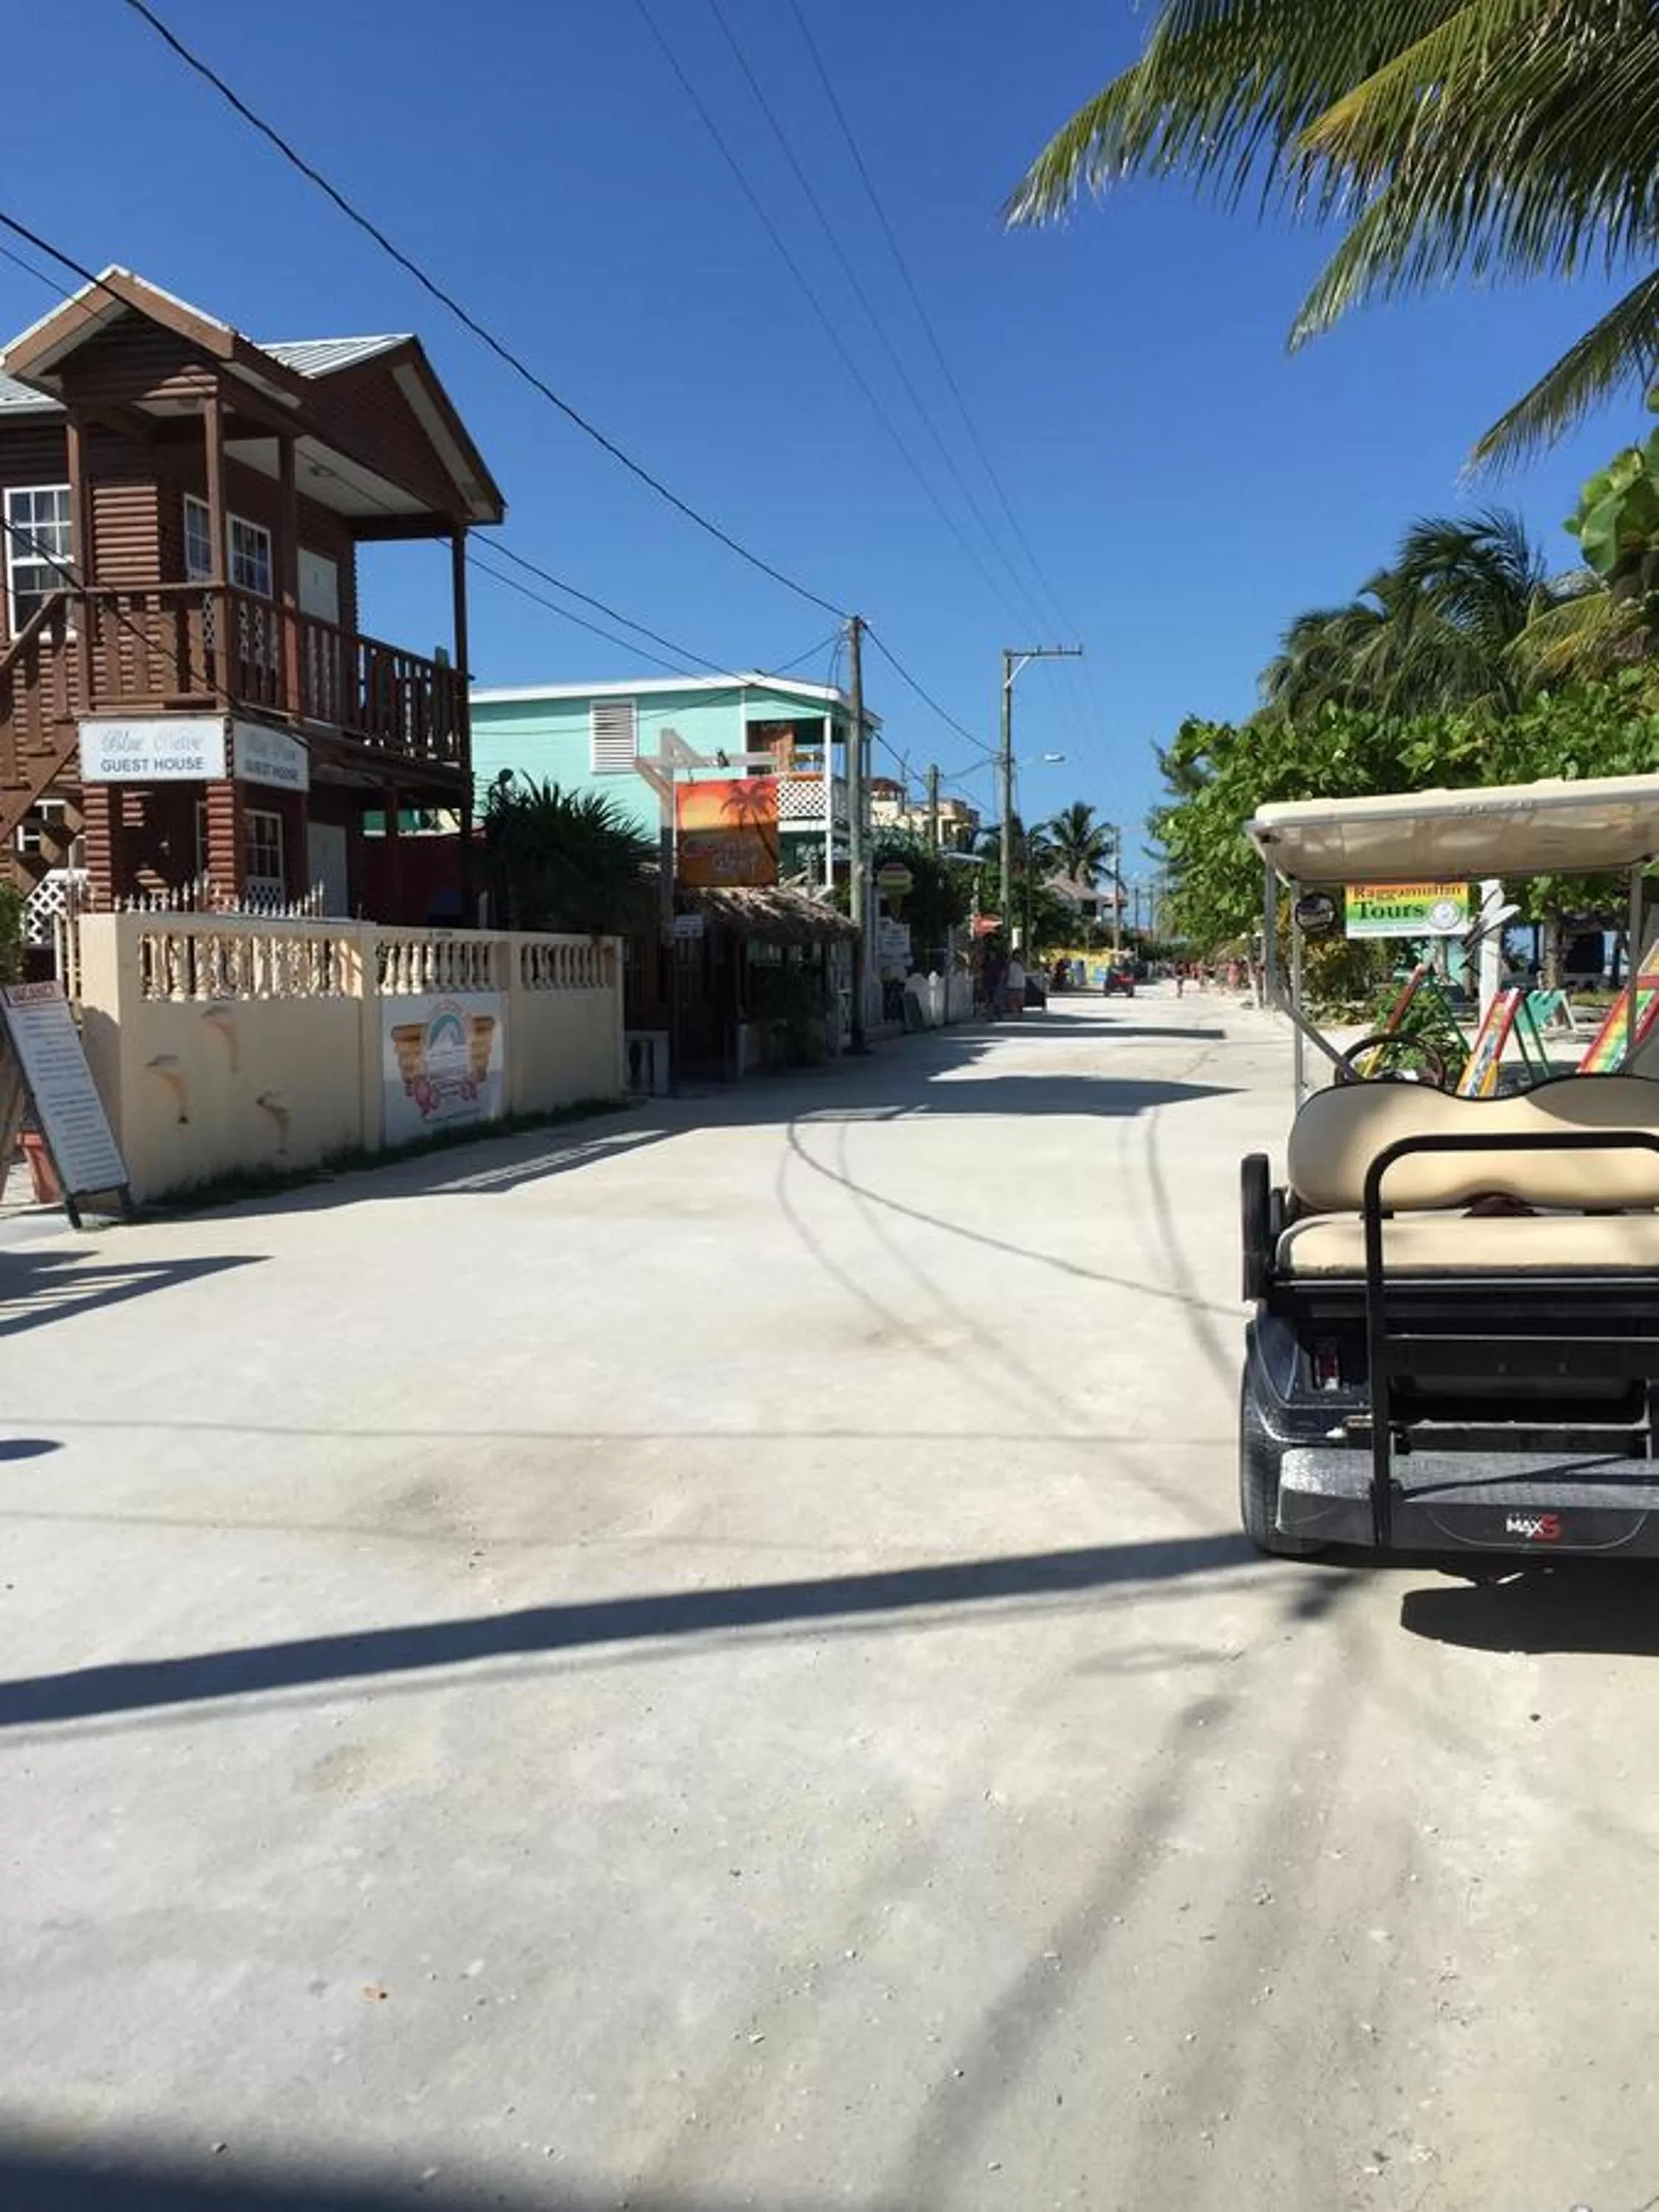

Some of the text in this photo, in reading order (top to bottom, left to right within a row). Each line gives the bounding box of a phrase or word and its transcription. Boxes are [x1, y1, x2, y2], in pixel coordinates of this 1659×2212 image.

[101, 757, 204, 772] GUEST HOUSE
[1354, 901, 1425, 919] Tours
